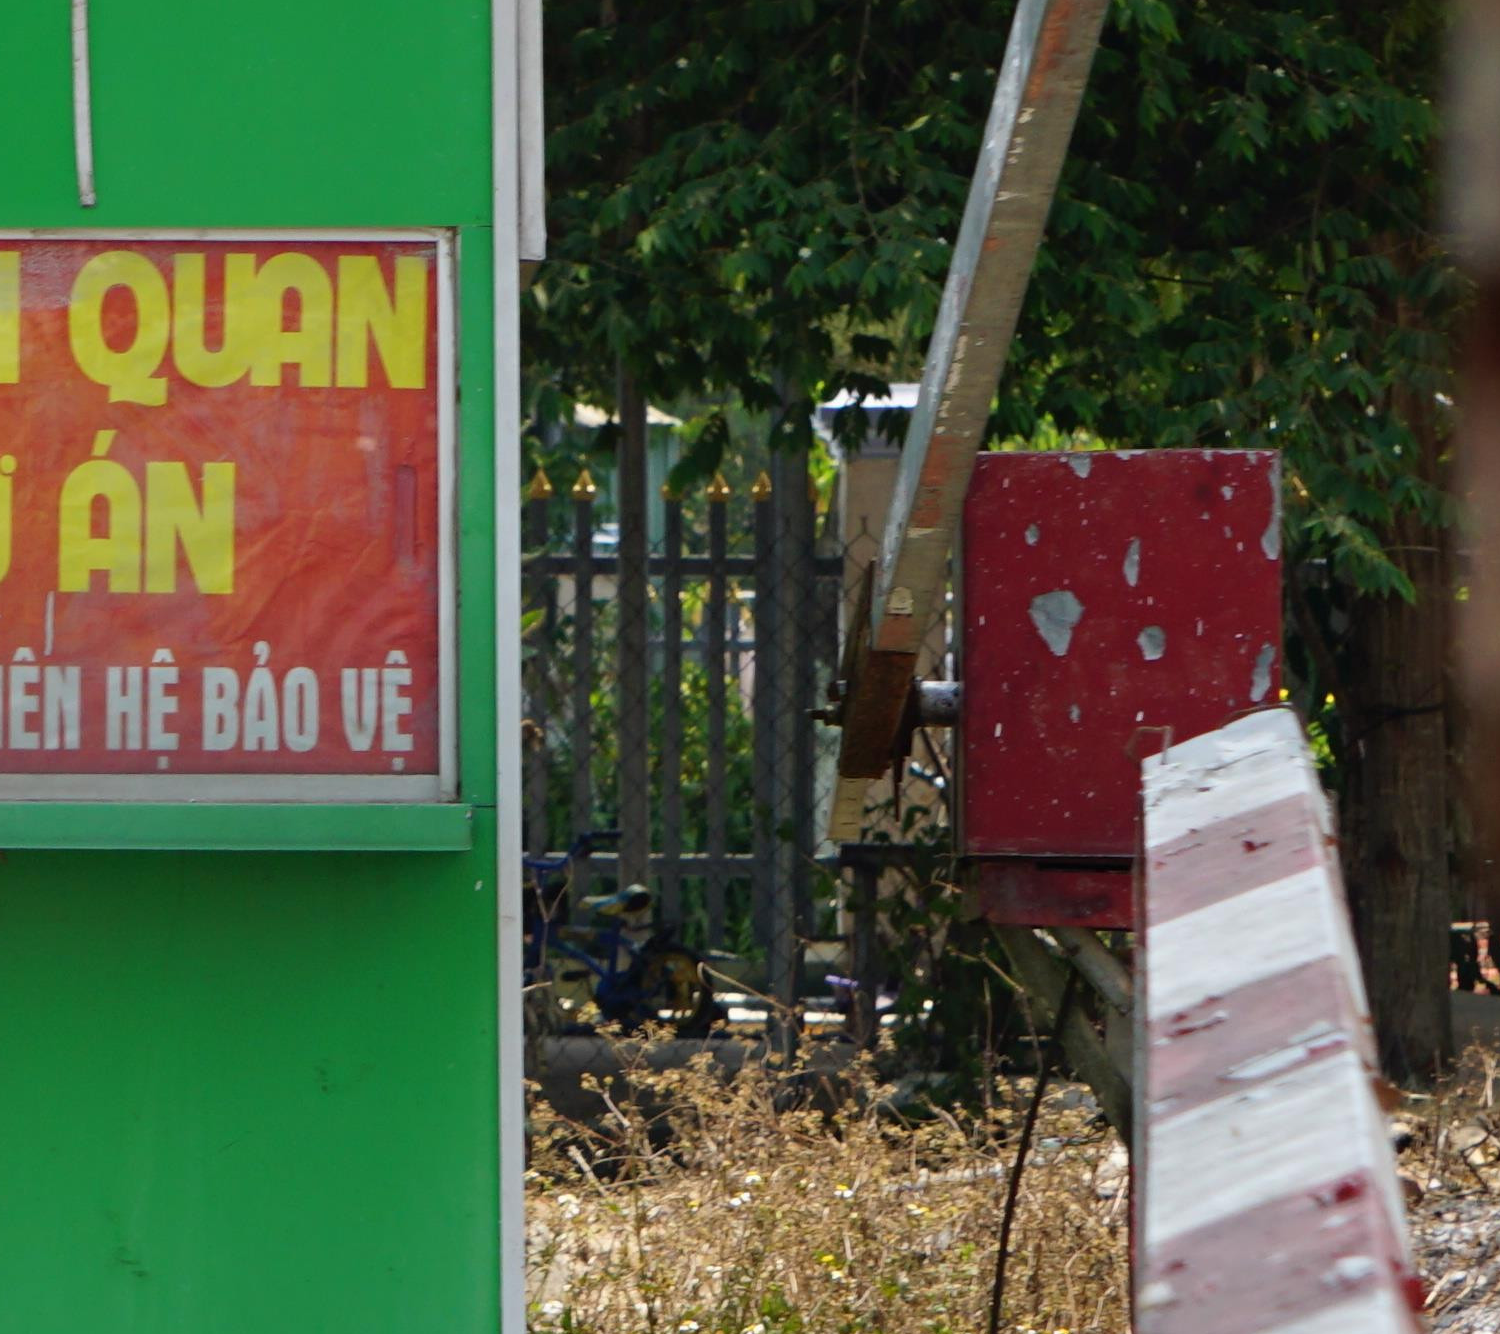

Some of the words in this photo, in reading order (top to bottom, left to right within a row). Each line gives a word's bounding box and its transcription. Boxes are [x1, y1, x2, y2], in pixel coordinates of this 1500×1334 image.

[68, 251, 429, 408] QUAN
[58, 429, 237, 595] ÁN
[105, 648, 180, 771] HỆ
[202, 640, 320, 754] BẢO
[340, 651, 414, 772] VỆ
